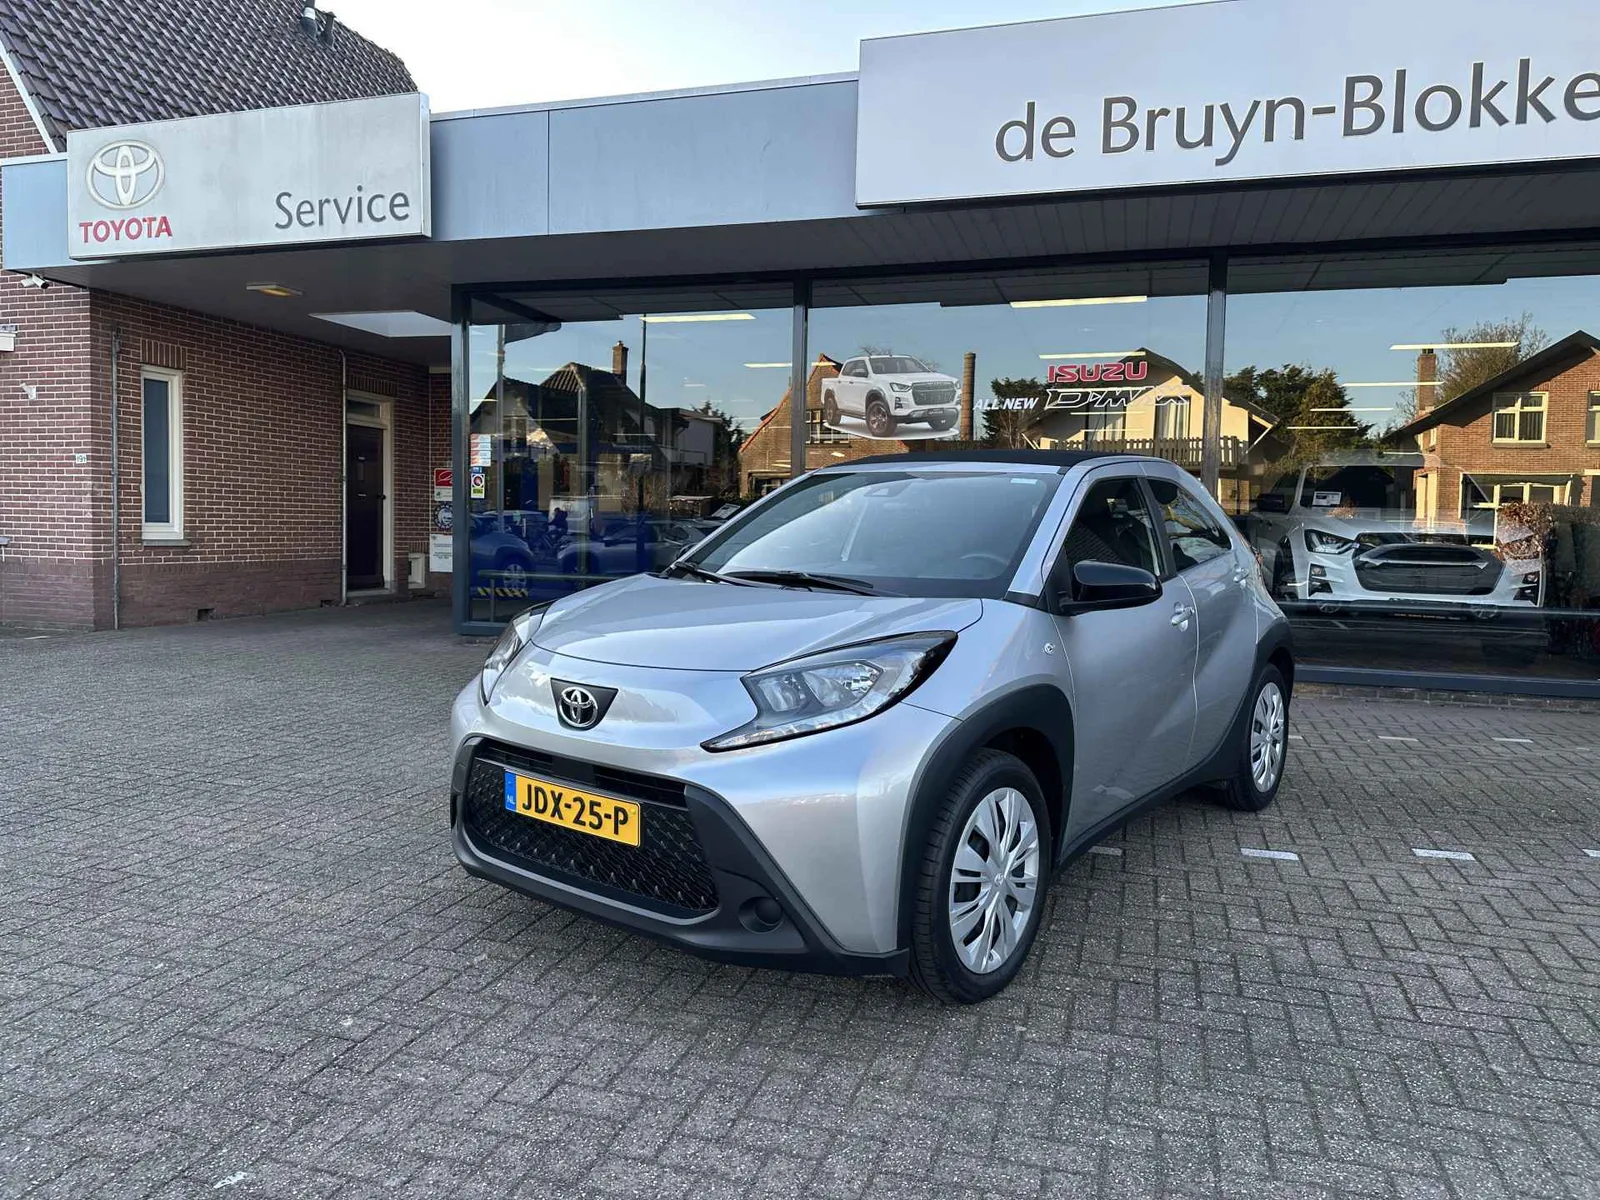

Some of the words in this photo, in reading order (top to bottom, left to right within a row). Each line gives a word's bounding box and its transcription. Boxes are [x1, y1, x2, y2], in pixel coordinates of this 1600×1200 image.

[996, 101, 1076, 163] de
[1102, 57, 1600, 167] Bruyn-Blokke
[274, 185, 411, 230] Service
[79, 216, 173, 244] TOYOTA
[1047, 361, 1149, 383] ISUZU
[973, 398, 999, 411] ALL
[1002, 397, 1039, 410] NEW
[522, 783, 629, 835] JDX-25-P
